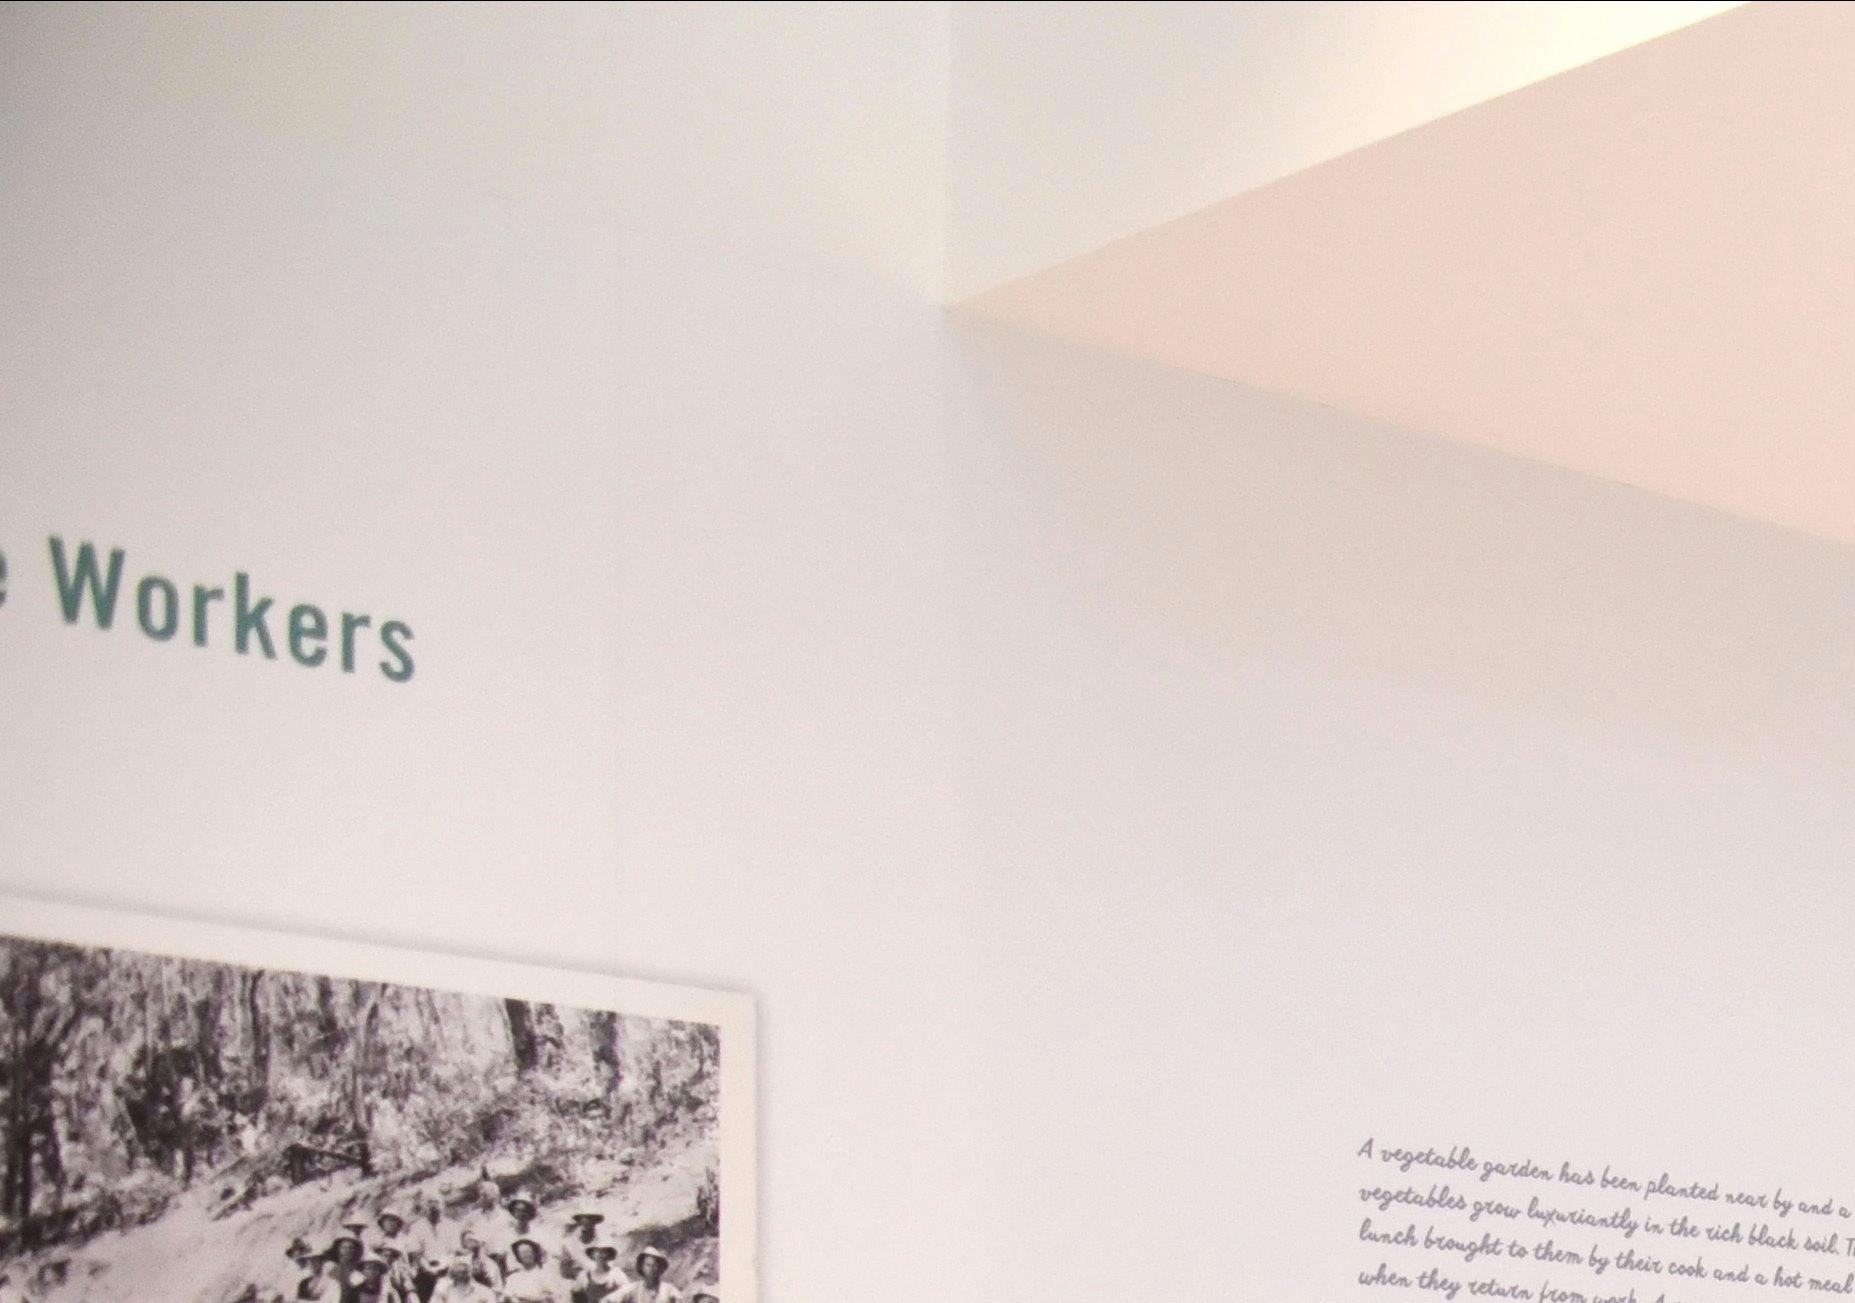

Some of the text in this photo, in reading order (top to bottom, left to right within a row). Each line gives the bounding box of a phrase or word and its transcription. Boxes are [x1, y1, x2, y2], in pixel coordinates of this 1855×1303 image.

[47, 534, 414, 683] Workers
[1358, 1137, 1374, 1158] A
[1381, 1146, 1478, 1172] vegetable
[1483, 1159, 1553, 1182] garden
[1559, 1161, 1596, 1185] has
[1601, 1166, 1641, 1192] been
[1644, 1172, 1719, 1200] planted
[1726, 1192, 1768, 1208] near
[1773, 1188, 1793, 1218] by
[1798, 1198, 1833, 1215] and
[1838, 1205, 1851, 1219] a
